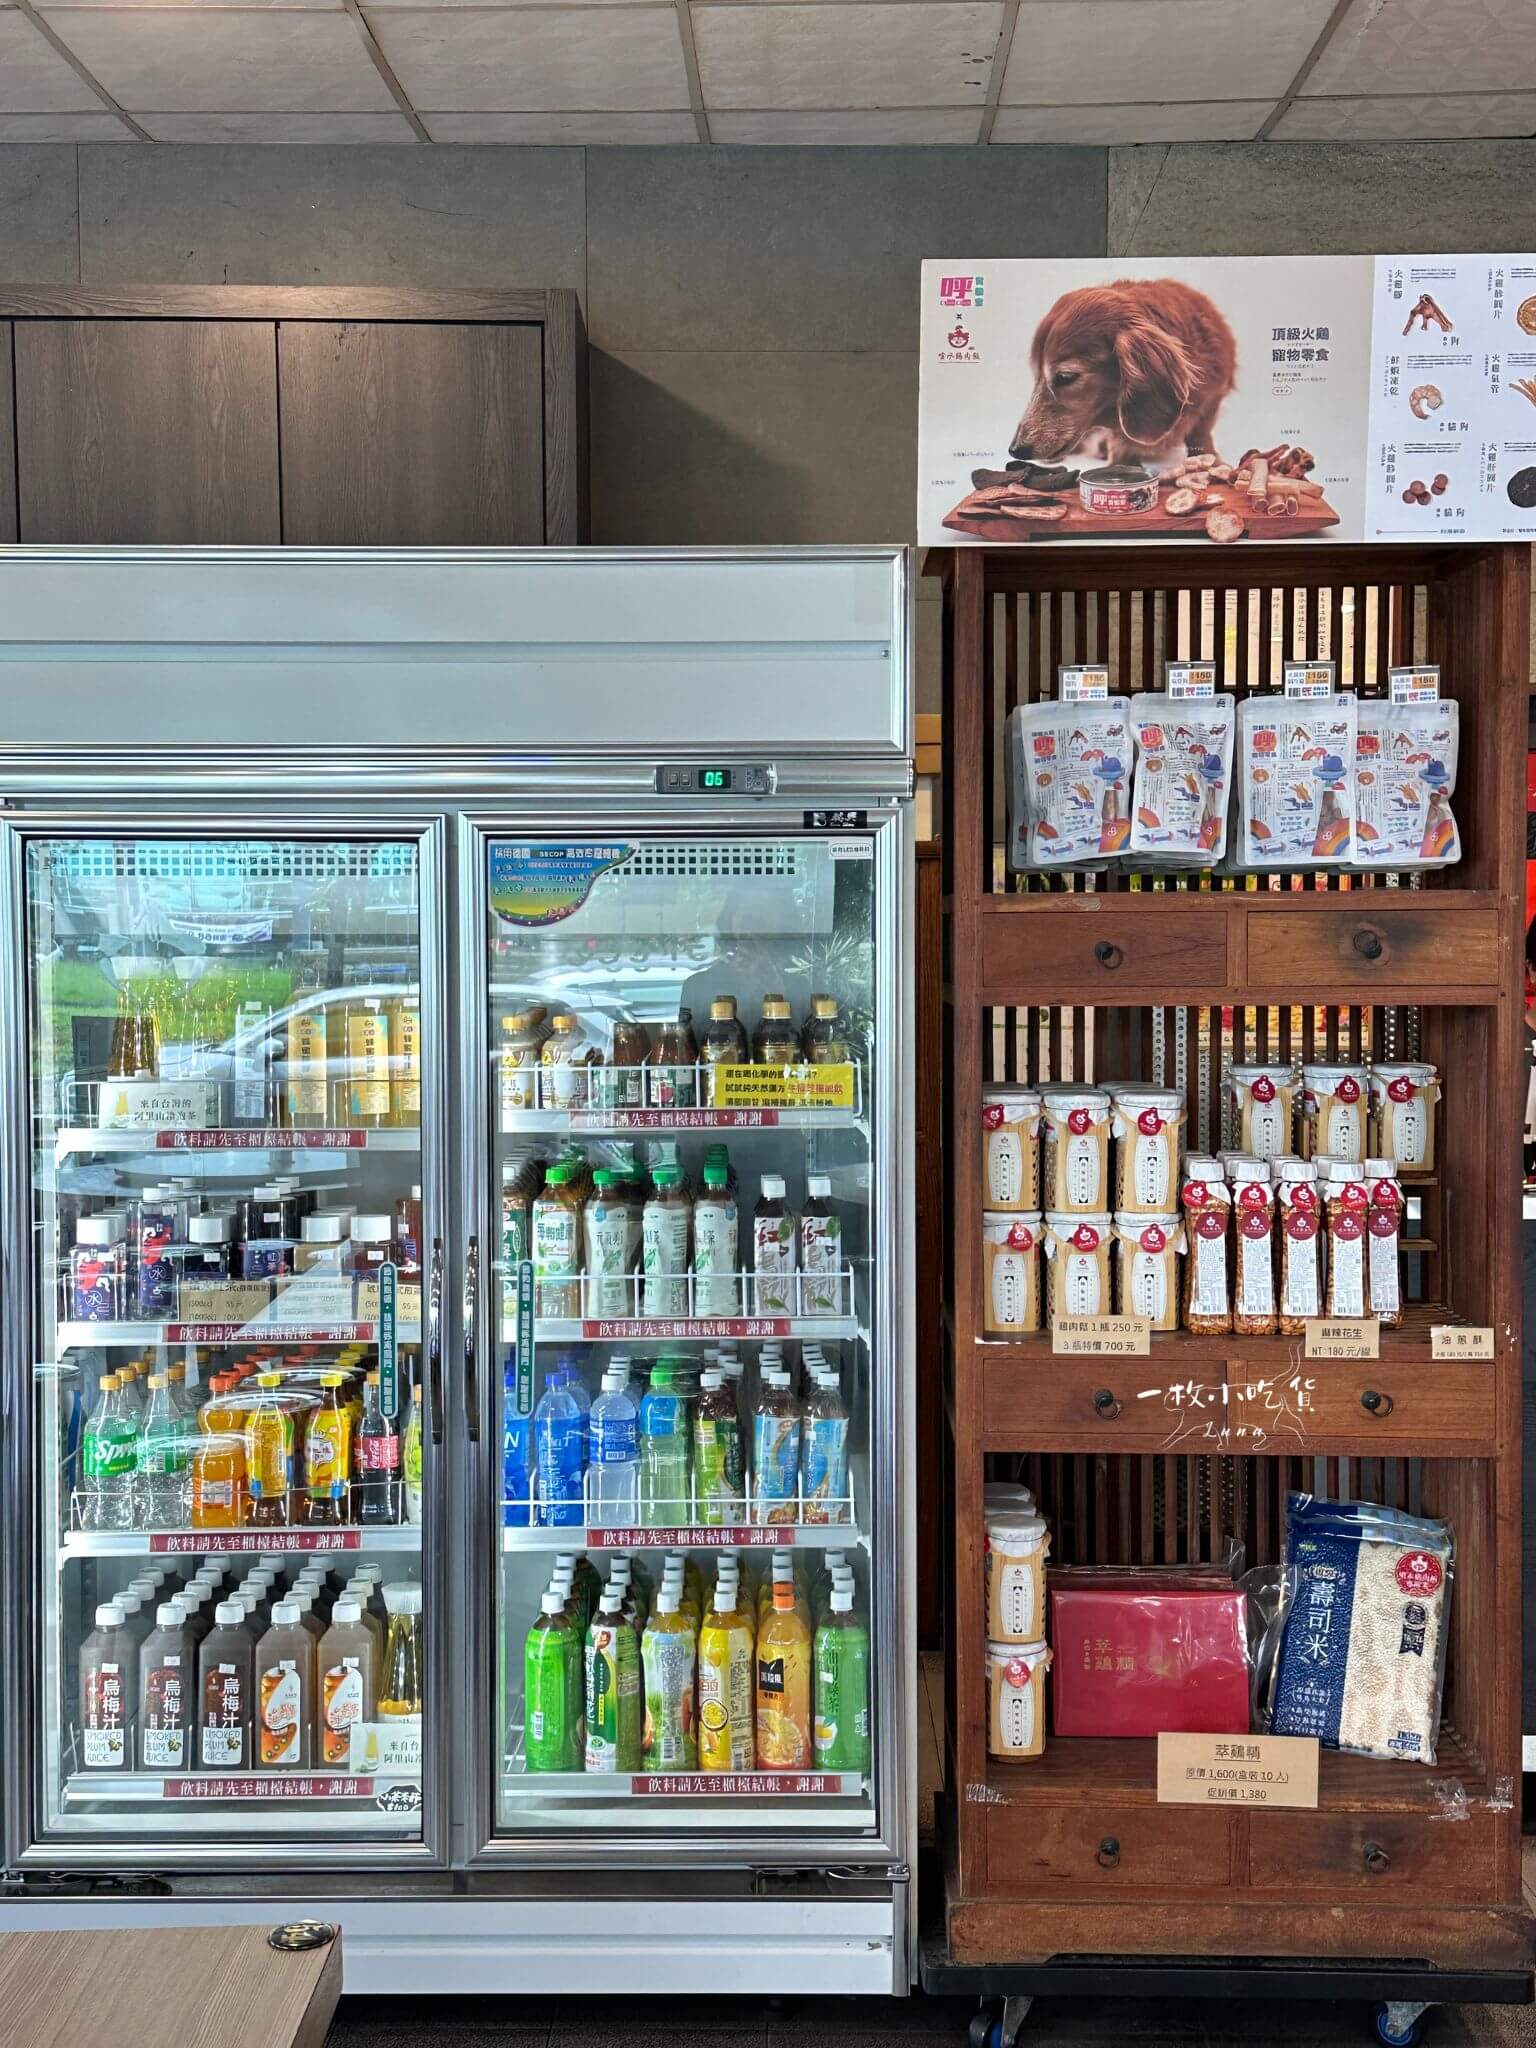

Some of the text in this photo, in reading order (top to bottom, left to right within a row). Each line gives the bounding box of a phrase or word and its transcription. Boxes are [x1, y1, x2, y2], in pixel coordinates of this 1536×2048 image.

[1272, 348, 1330, 362] 寵物零食
[704, 771, 724, 787] 06
[1091, 1322, 1097, 1331] 1
[1112, 1322, 1131, 1332] 250
[1133, 1322, 1144, 1332] 元
[1321, 1327, 1362, 1338] 麻辣花生
[1104, 1341, 1123, 1351] 700
[1126, 1341, 1136, 1351] 元
[1303, 1581, 1336, 1659] 壽司米
[103, 1678, 121, 1730] 烏梅汁
[163, 1679, 182, 1730] 烏梅汁
[221, 1677, 240, 1729] 烏梅汁
[1263, 1770, 1273, 1781] 10
[1241, 1789, 1267, 1801] 1,380
